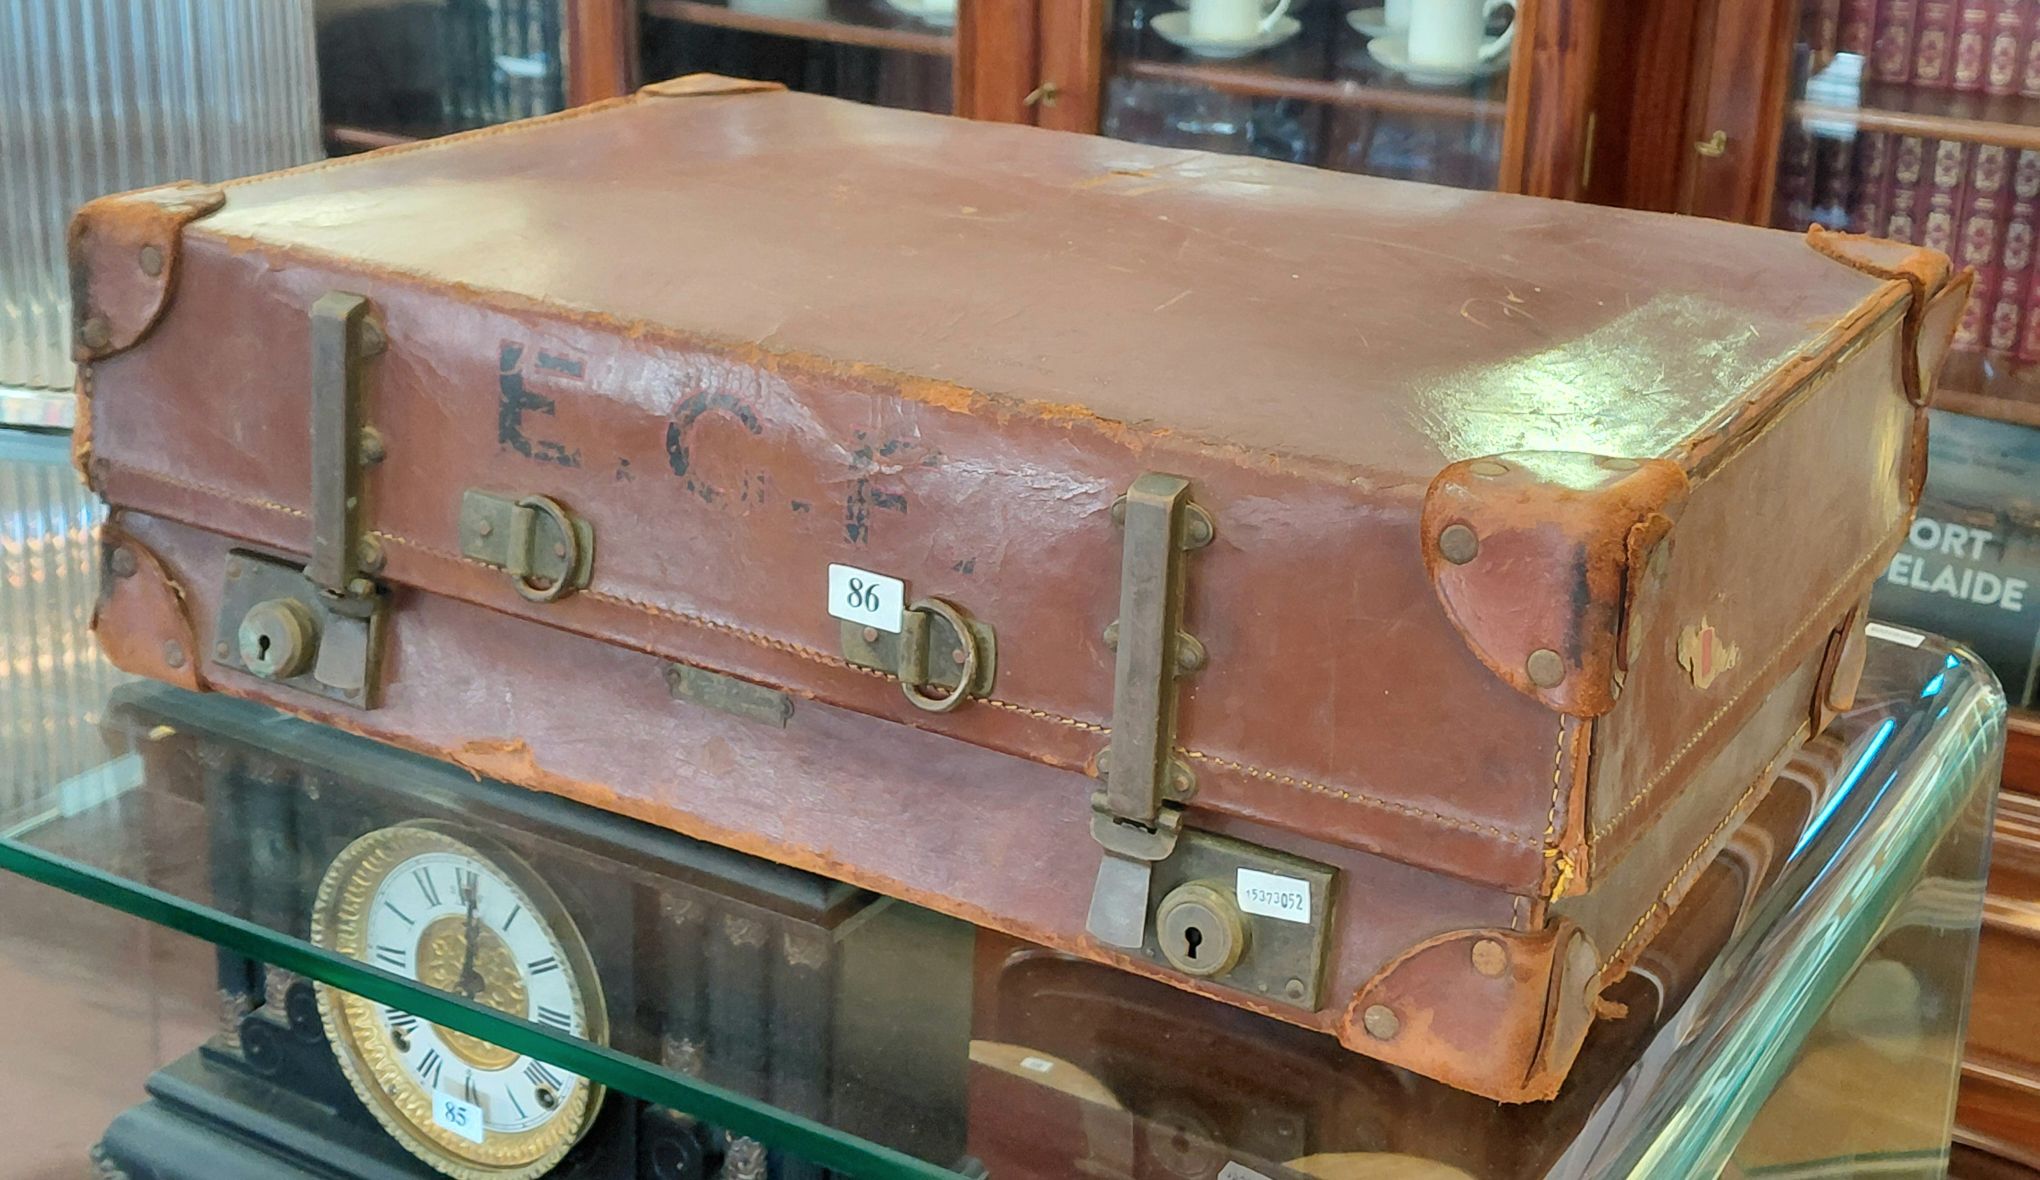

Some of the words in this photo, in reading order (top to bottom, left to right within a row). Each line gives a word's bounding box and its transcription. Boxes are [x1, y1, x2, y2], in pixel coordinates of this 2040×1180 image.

[847, 578, 881, 613] 86
[1246, 888, 1303, 911] 15373052
[444, 1101, 467, 1126] 85
